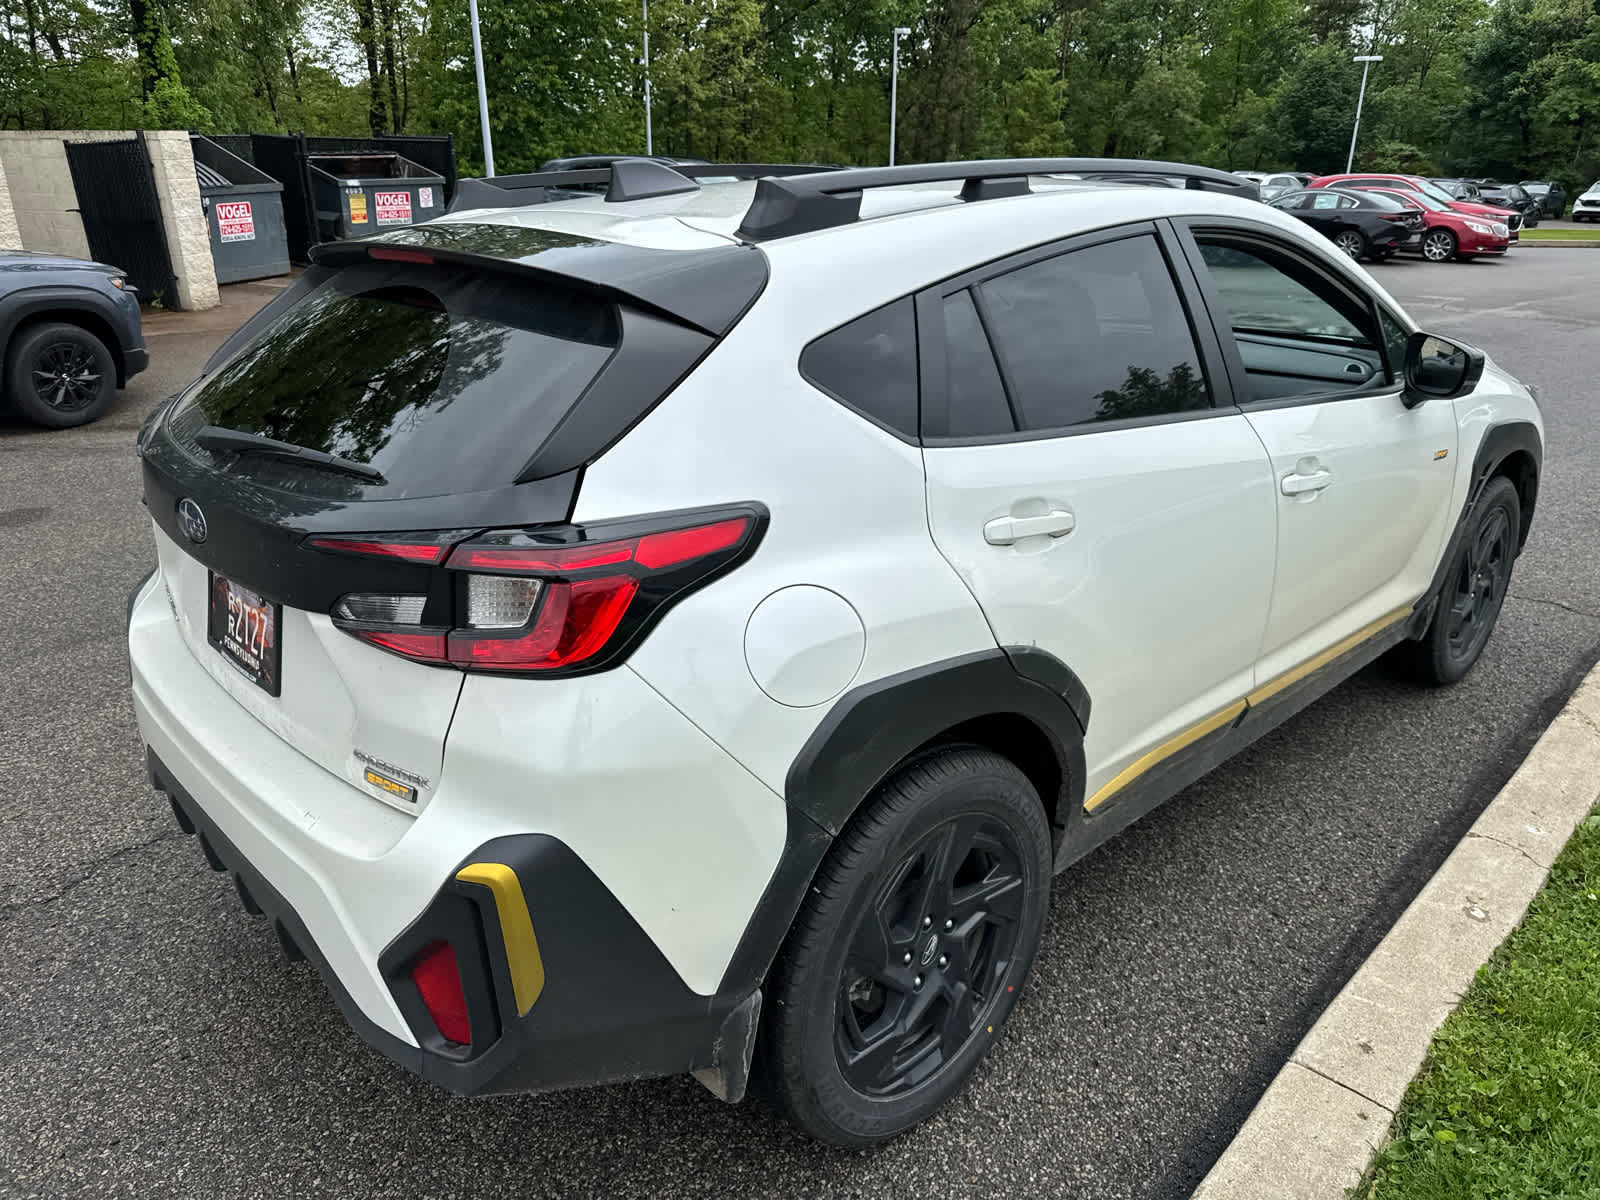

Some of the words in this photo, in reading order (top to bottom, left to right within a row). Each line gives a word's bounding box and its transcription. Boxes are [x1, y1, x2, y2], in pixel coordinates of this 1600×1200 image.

[376, 194, 409, 206] VOGEL
[218, 204, 250, 219] VOGEL
[367, 771, 409, 798] SPORT
